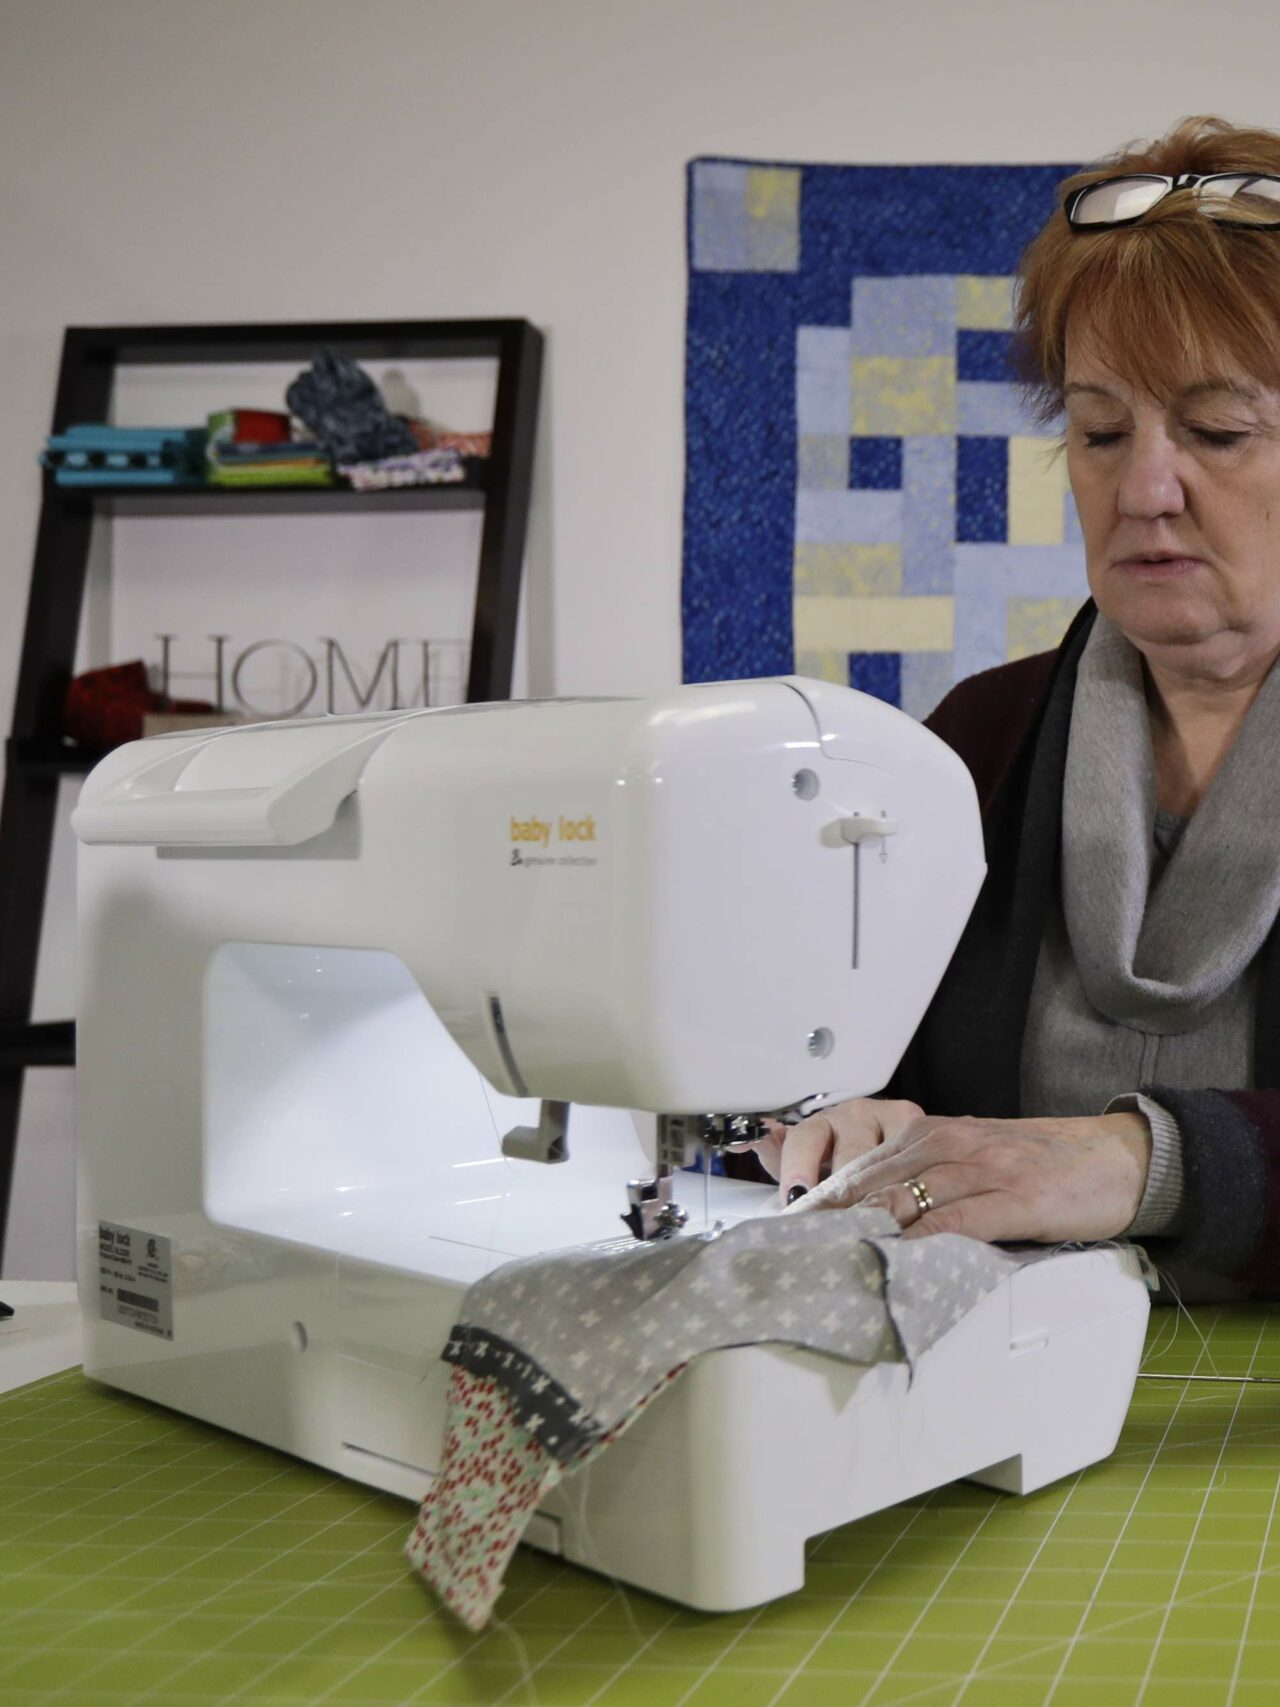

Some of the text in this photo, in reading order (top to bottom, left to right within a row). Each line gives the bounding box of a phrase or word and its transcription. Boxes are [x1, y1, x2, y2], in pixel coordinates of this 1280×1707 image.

[154, 633, 468, 721] HOME
[510, 813, 597, 848] baby lock
